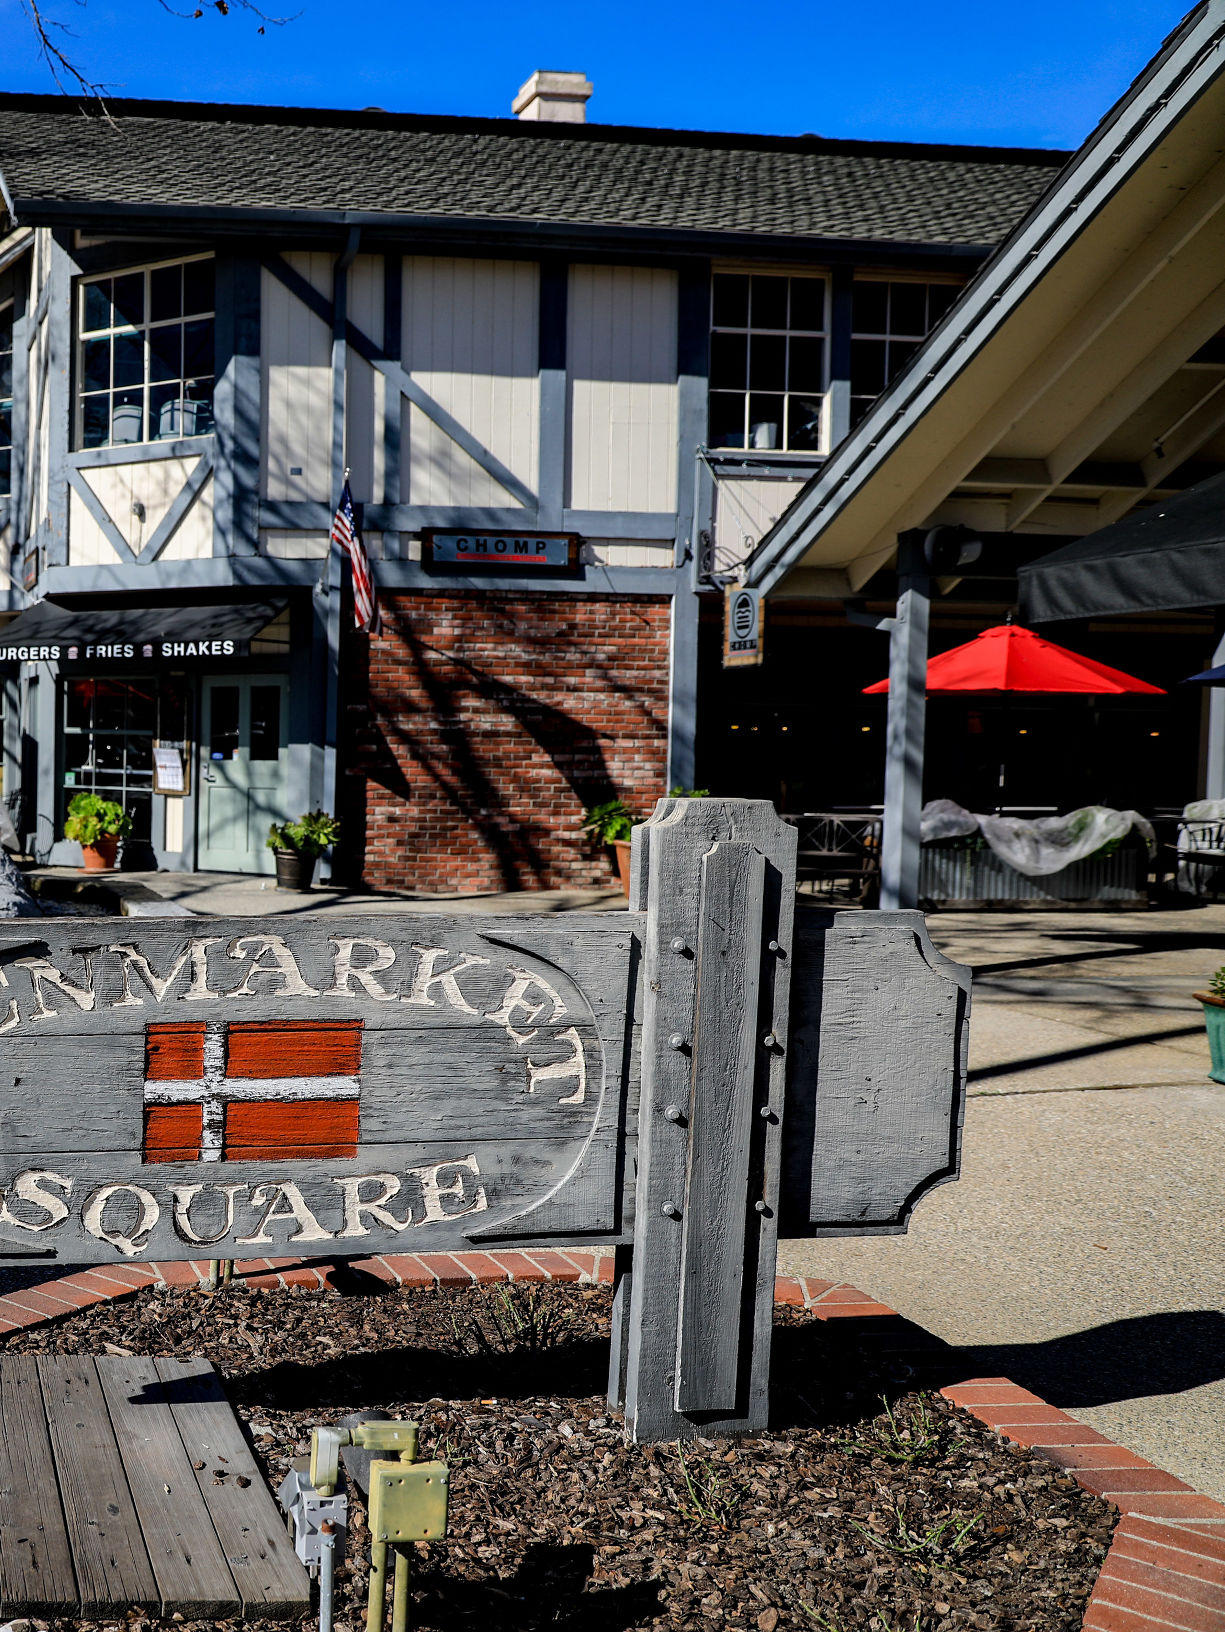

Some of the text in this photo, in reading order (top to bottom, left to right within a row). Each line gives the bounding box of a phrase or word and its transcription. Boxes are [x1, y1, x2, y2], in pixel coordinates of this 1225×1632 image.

[456, 538, 547, 554] CHOMP
[85, 644, 134, 658] FRIES
[161, 640, 235, 657] SHAKES
